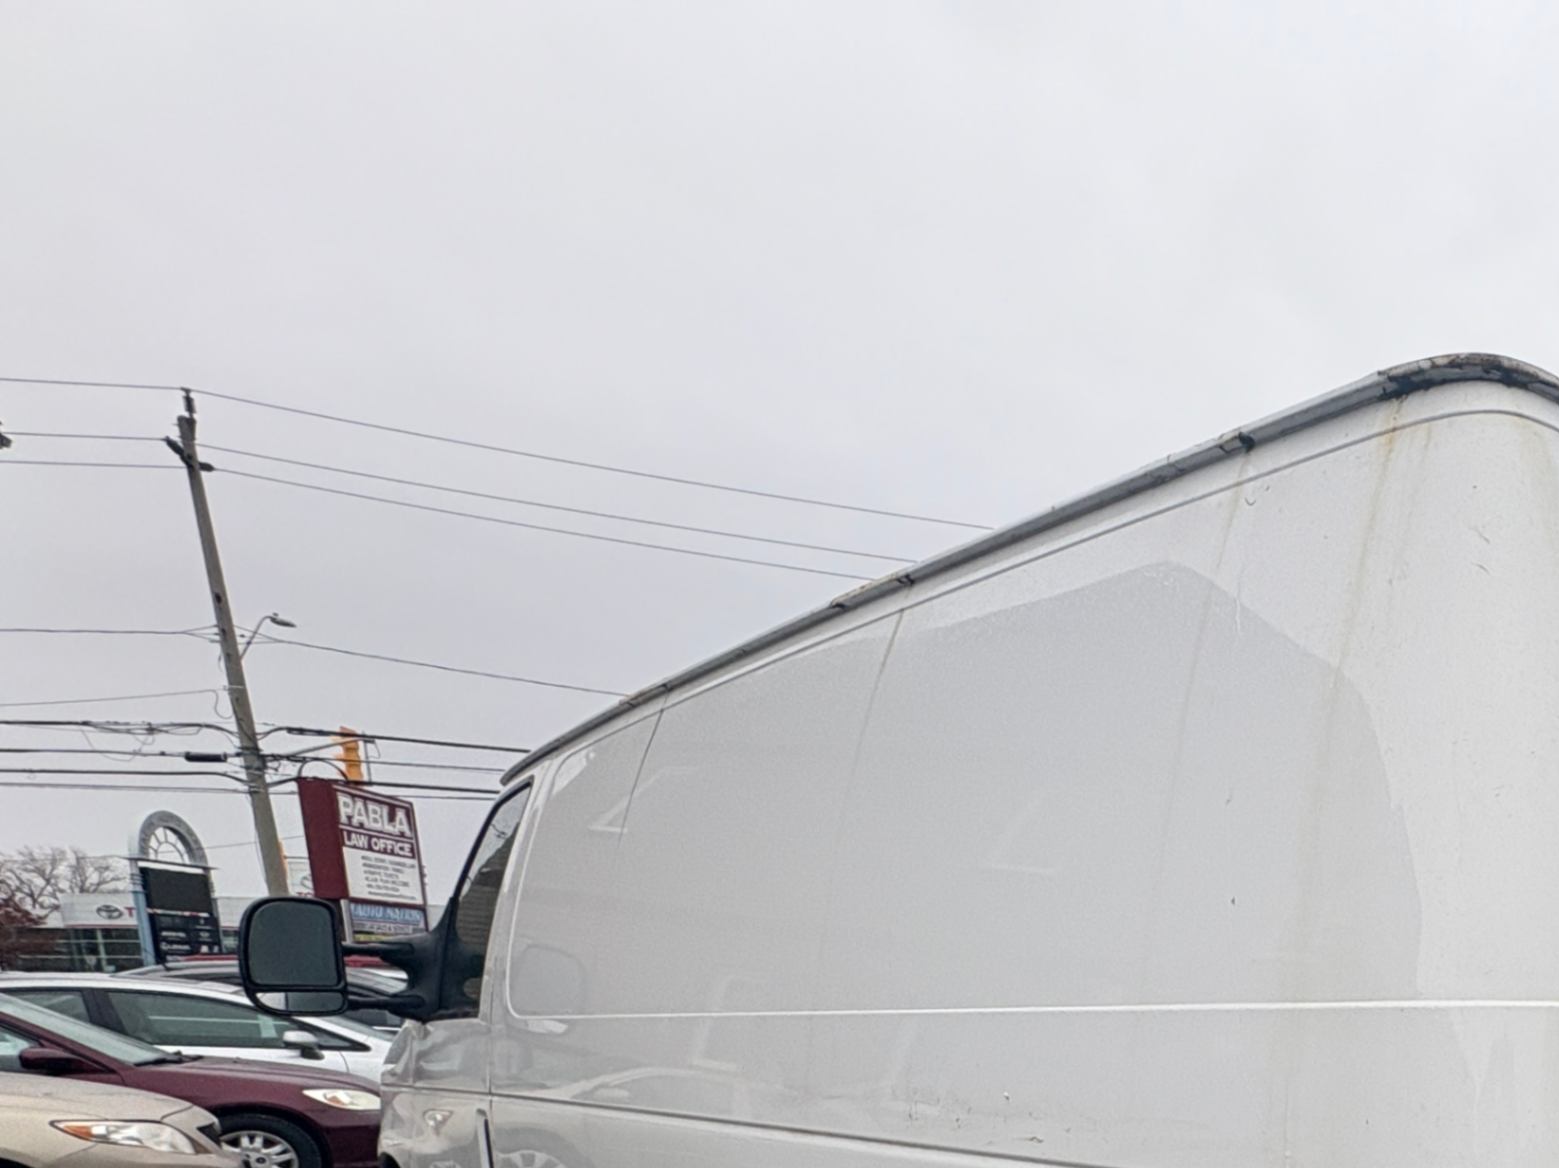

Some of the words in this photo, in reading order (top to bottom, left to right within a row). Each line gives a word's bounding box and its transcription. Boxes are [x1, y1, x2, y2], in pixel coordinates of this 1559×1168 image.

[337, 792, 412, 837] PABLA
[343, 830, 369, 849] LAW
[371, 835, 413, 857] OFFICE
